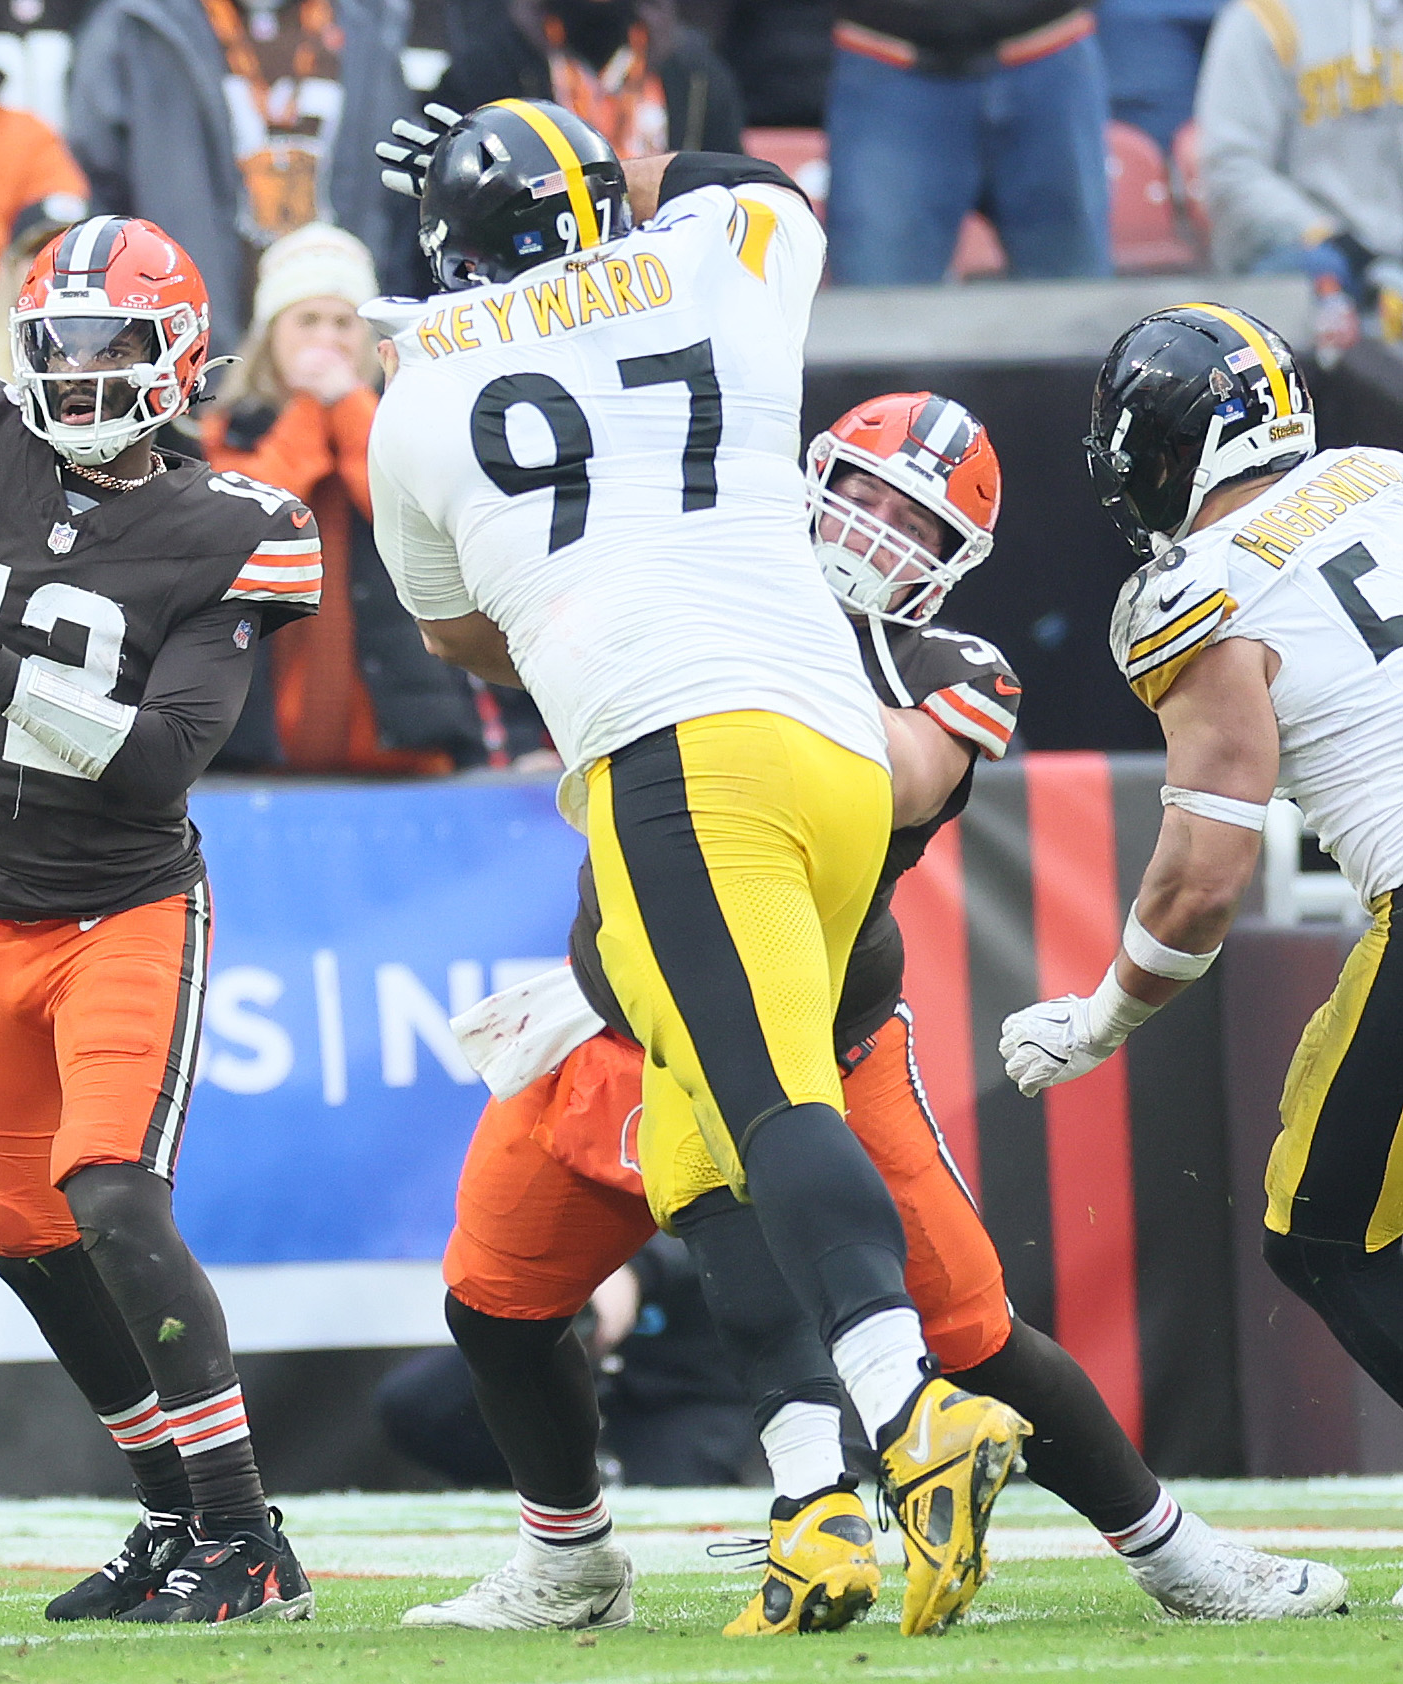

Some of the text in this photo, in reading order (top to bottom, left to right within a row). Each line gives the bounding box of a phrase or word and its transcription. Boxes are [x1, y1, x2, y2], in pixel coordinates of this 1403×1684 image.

[417, 253, 672, 359] HEYWARD
[470, 337, 722, 555] 97
[1250, 372, 1303, 422] 56
